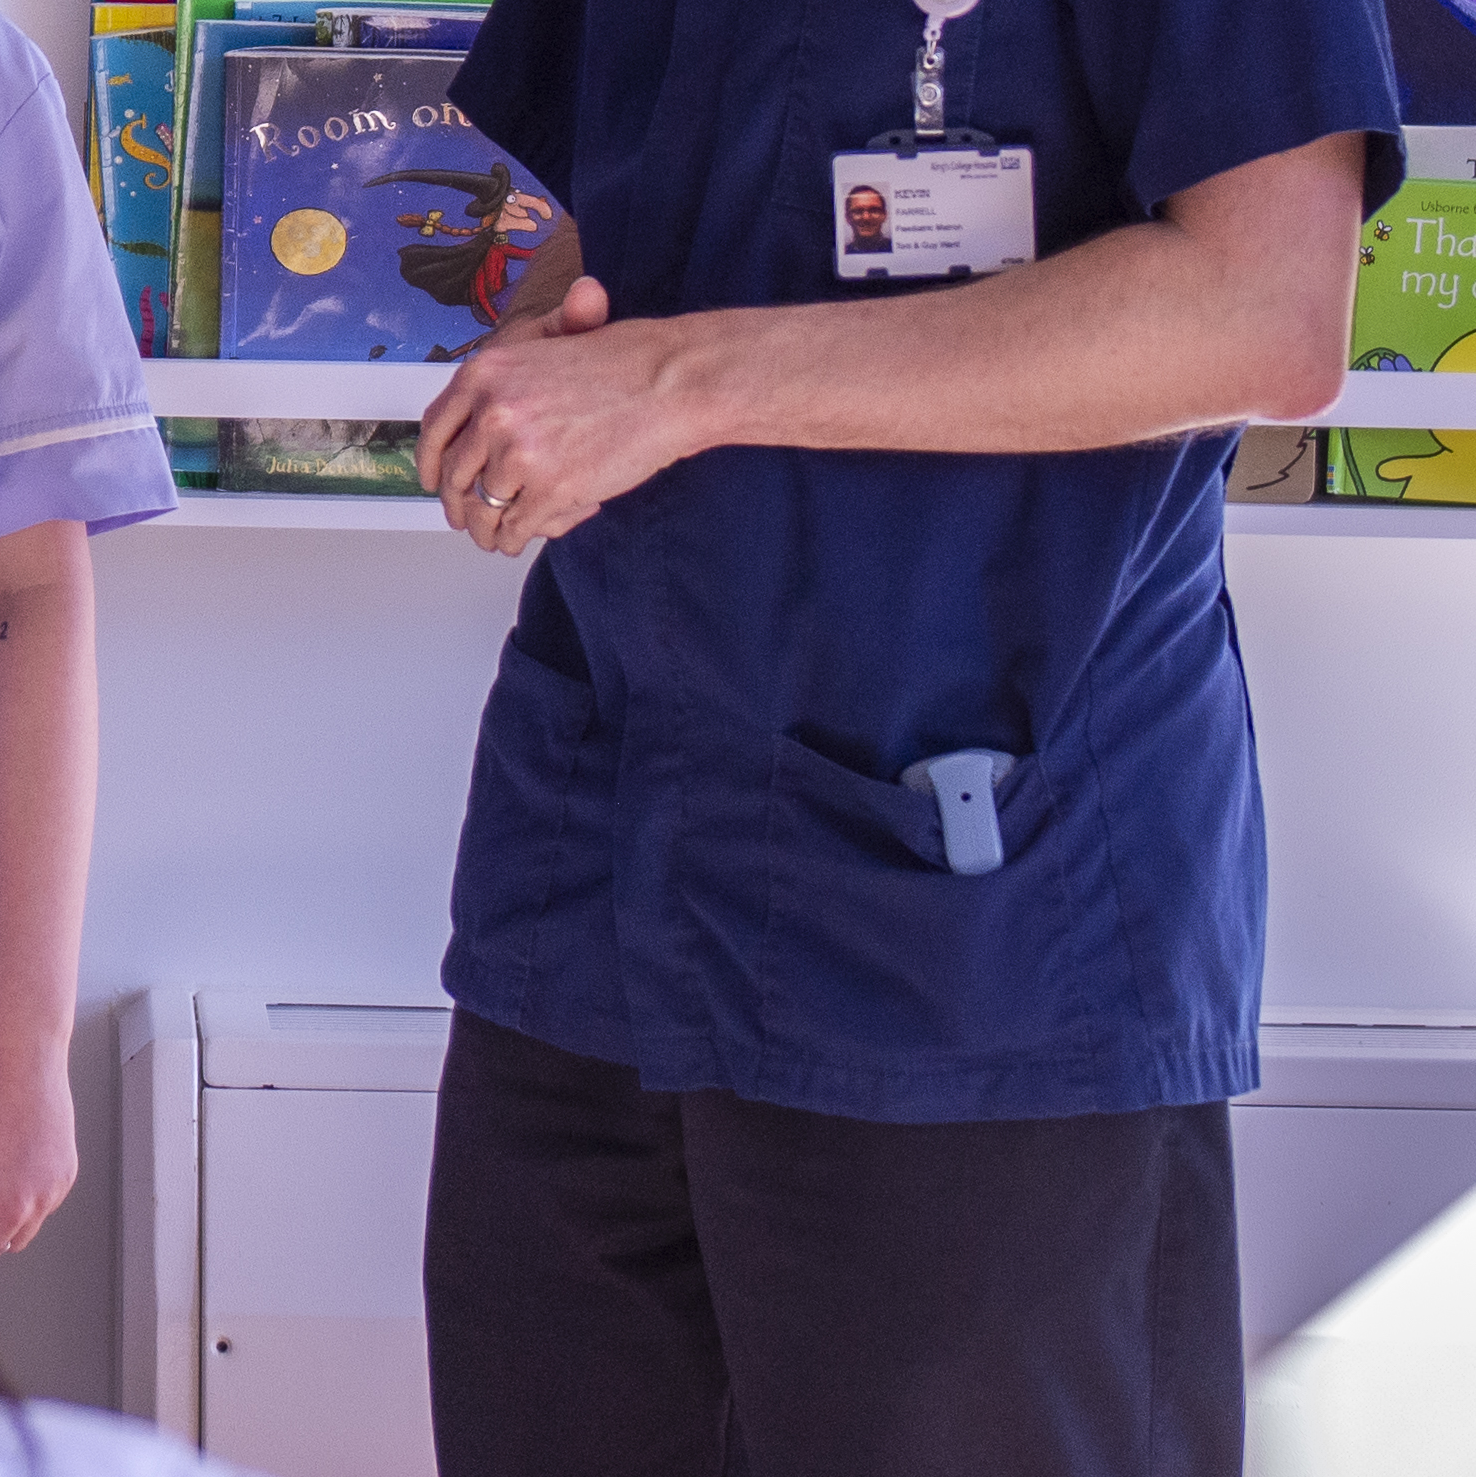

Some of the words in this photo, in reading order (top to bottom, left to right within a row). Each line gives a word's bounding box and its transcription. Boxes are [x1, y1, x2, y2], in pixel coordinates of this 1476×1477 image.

[249, 108, 397, 163] Room
[412, 102, 472, 128] on
[1421, 200, 1470, 214] Usborne
[1402, 271, 1459, 309] my
[266, 457, 310, 474] Julia
[316, 458, 407, 475] Donaldson
